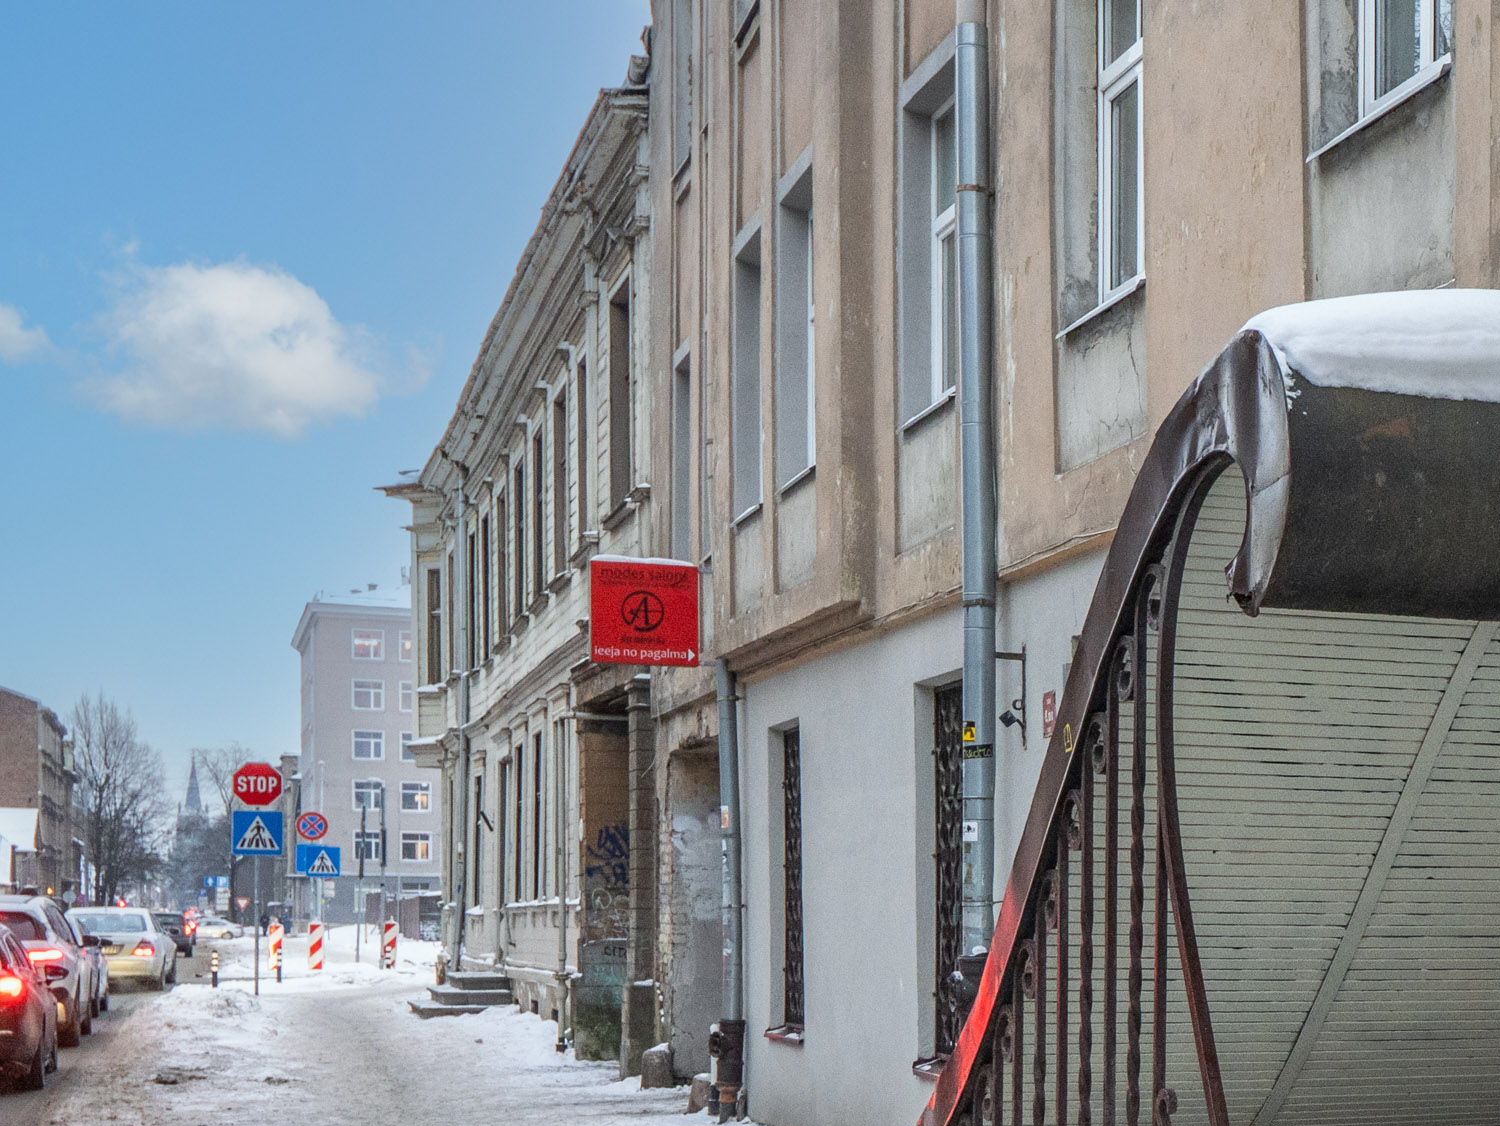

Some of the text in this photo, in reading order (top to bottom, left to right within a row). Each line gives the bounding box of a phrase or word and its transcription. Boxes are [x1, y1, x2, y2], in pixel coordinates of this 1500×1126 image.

[601, 567, 644, 579] modes
[594, 646, 687, 660] ieeja no pagalma
[237, 775, 277, 793] STOP
